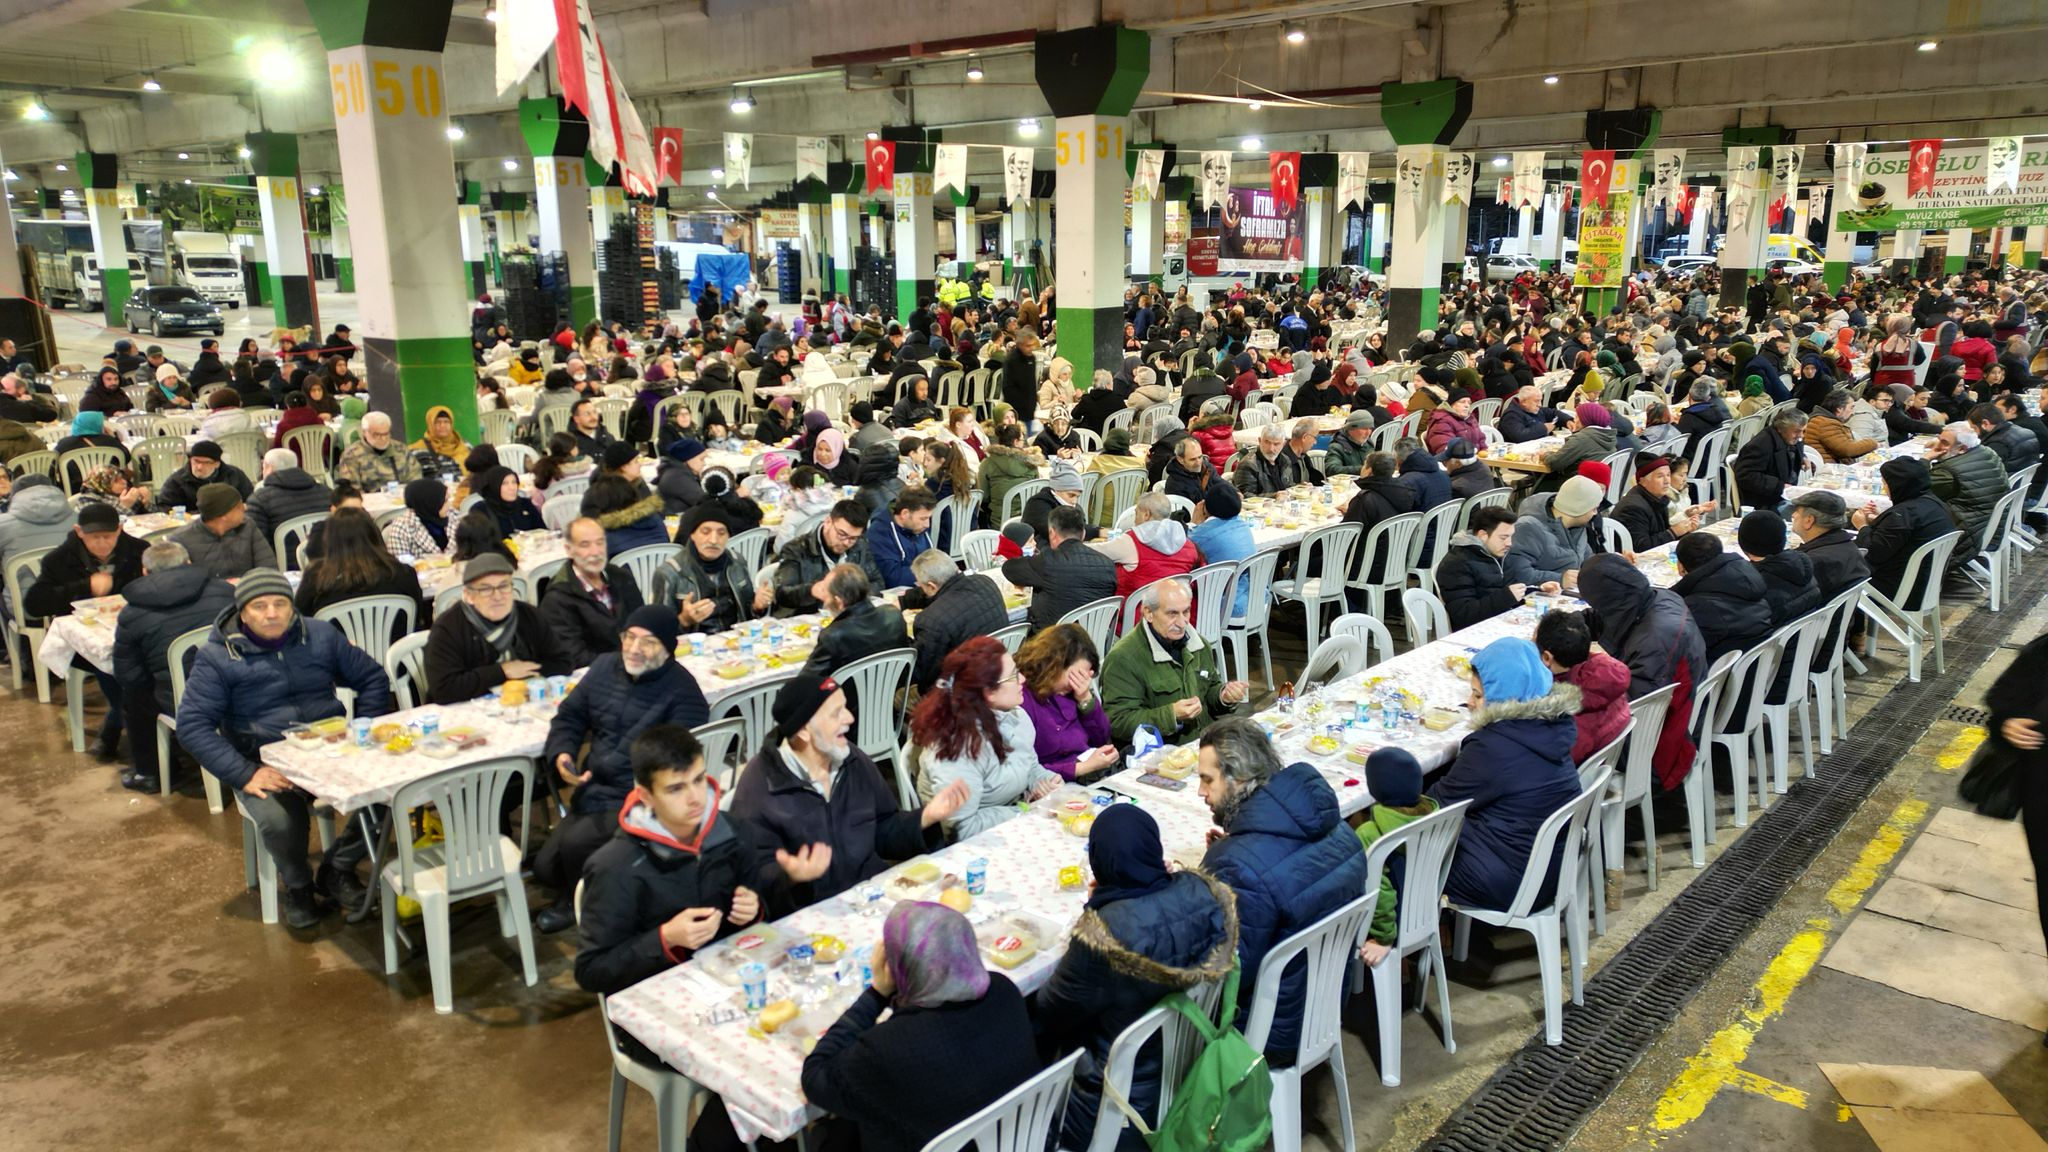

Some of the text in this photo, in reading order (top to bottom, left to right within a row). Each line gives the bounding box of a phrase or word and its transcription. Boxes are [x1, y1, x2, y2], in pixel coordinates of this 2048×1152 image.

[331, 63, 365, 118] 50
[372, 61, 442, 118] 50
[1056, 130, 1086, 166] 51
[1096, 124, 1123, 160] 51
[556, 161, 582, 187] 51
[1862, 154, 1981, 177] ÖSEĞLU
[1933, 174, 1988, 187] ZEYTİNC
[222, 196, 261, 207] ZEY
[1240, 216, 1287, 239] SOFRAMIZA
[1905, 211, 1933, 220] YAVUZ
